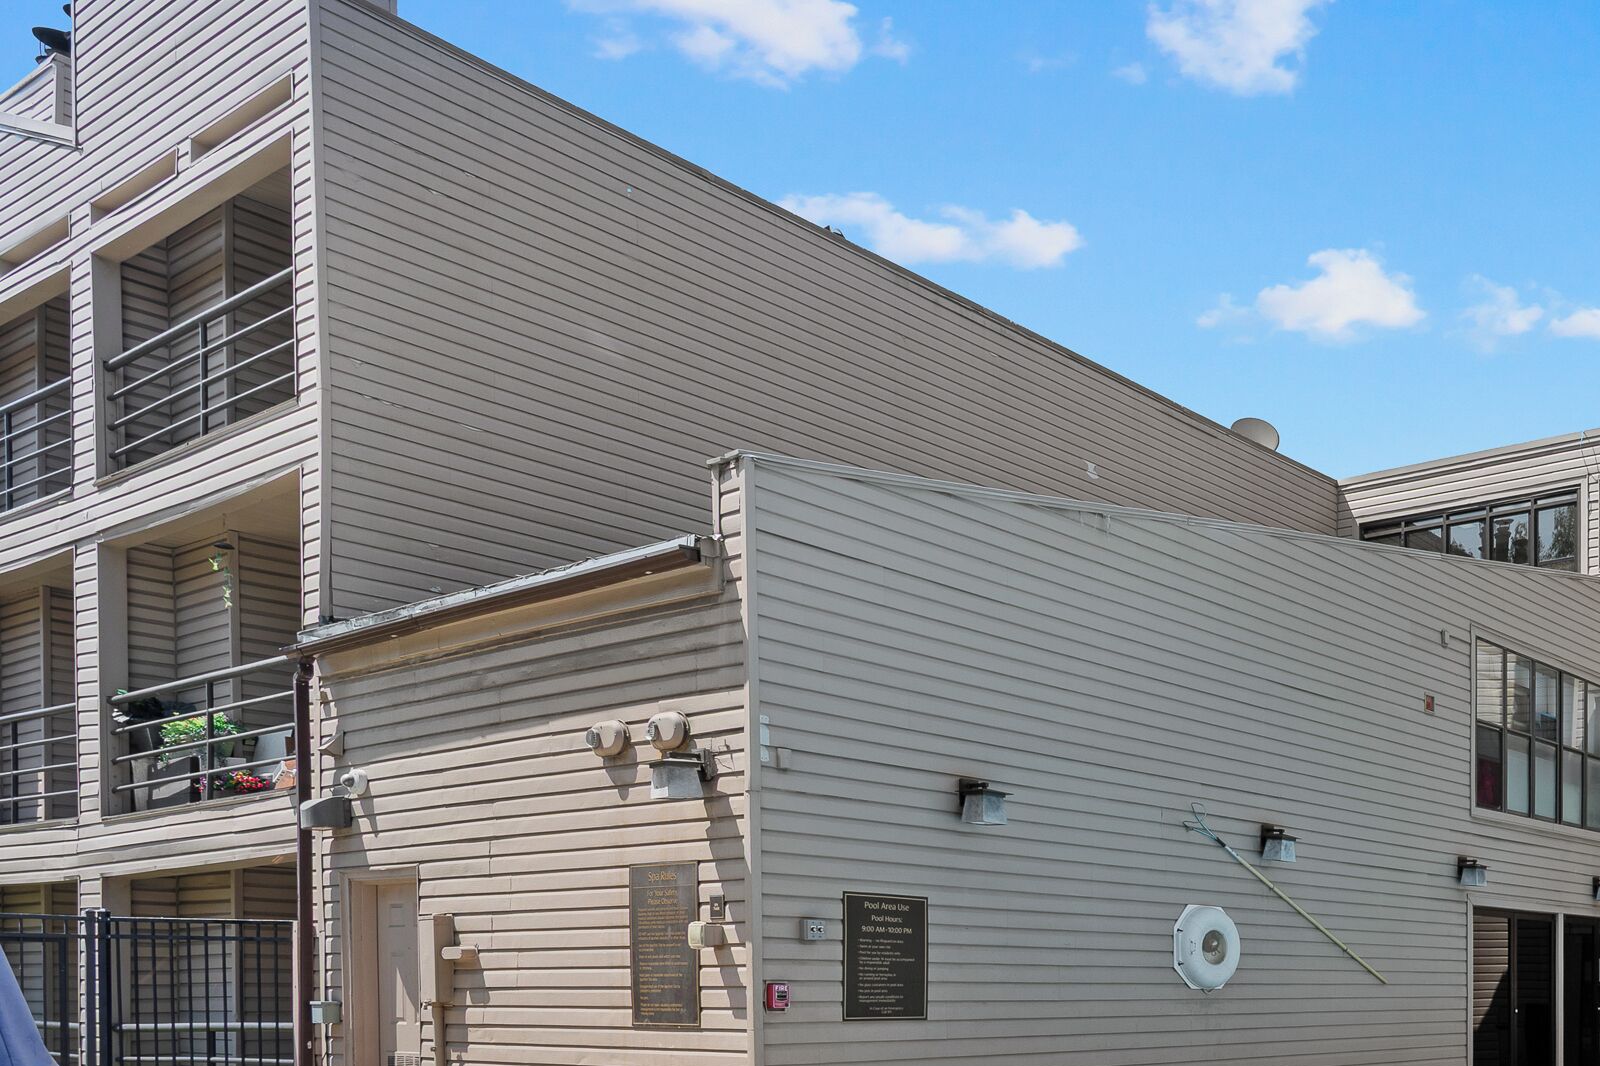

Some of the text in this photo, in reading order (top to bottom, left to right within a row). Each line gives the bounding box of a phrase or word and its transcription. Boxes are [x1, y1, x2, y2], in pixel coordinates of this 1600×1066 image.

[647, 871, 677, 883] Spa Rules
[864, 901, 910, 912] Pool Area Use
[871, 914, 903, 923] Pool Hours:
[861, 925, 874, 933] 9:00
